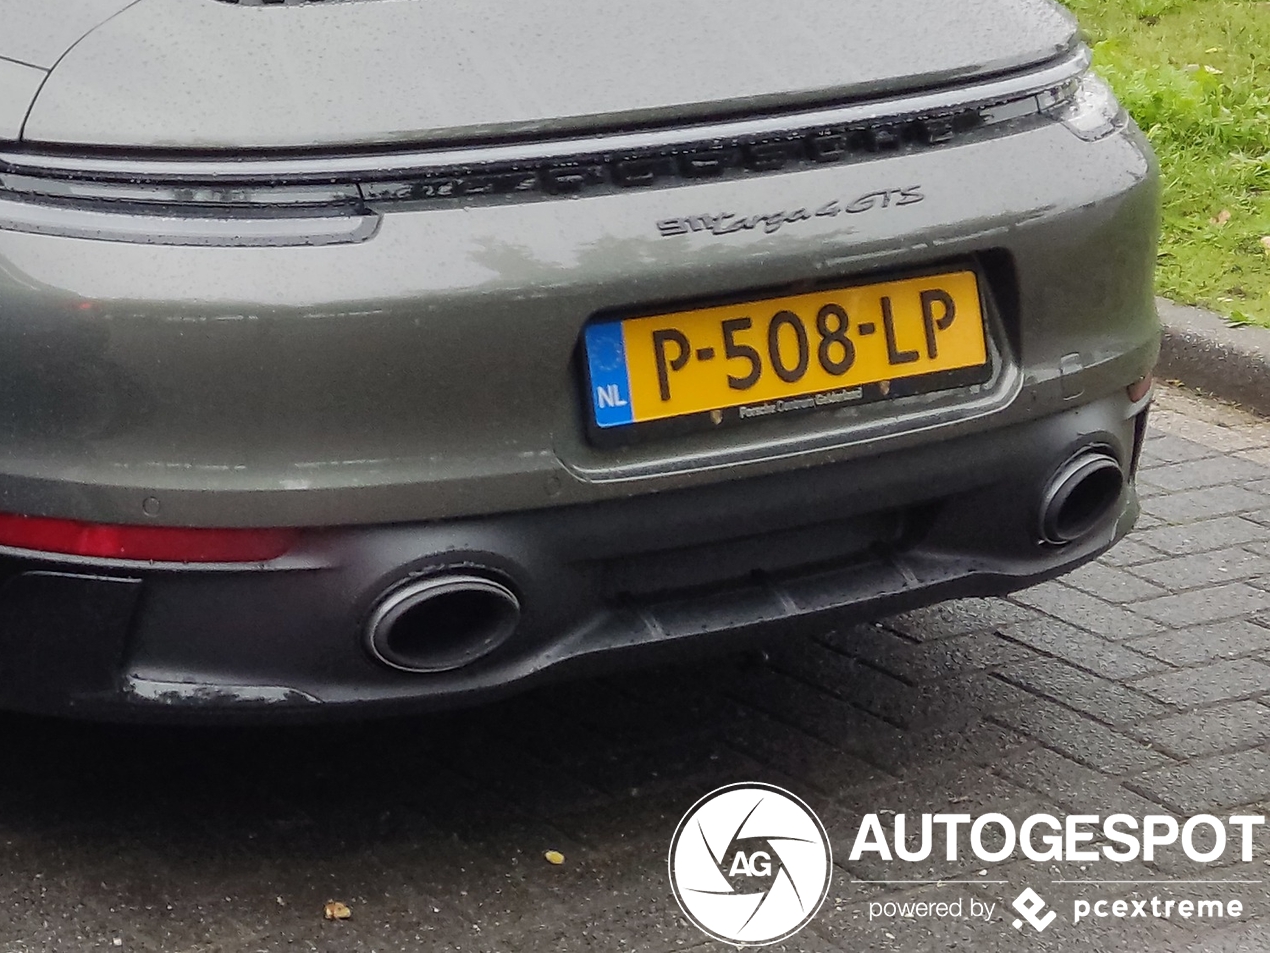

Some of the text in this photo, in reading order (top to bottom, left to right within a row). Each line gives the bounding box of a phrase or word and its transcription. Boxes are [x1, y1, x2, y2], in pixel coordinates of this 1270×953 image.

[815, 200, 841, 217] 4
[845, 185, 925, 214] GTS
[652, 288, 956, 402] P-508-LP
[597, 383, 628, 408] NL
